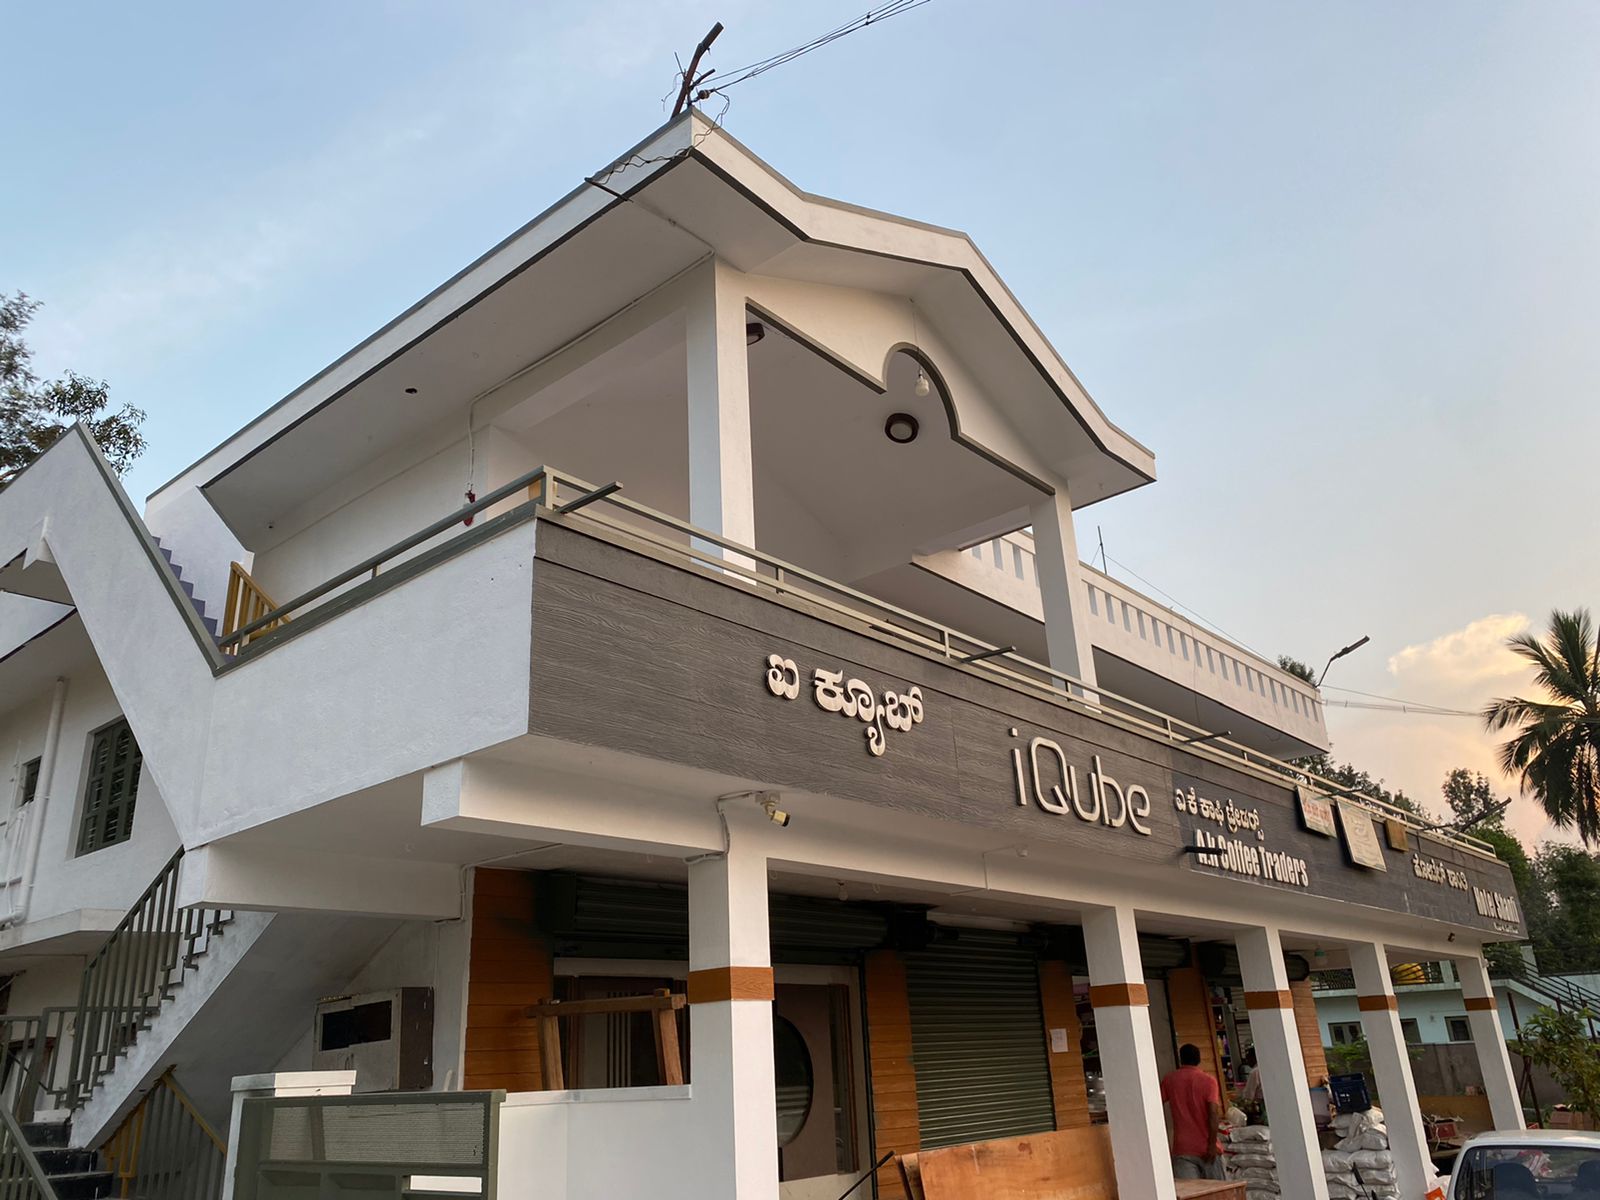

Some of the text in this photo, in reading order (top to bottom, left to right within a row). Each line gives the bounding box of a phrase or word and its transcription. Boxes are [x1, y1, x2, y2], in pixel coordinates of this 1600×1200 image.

[765, 653, 925, 757] ಐ ಕ್ಯೂಬ್
[1009, 727, 1152, 836] iQube
[1218, 834, 1261, 876] Coffee
[1259, 845, 1309, 887] Traders
